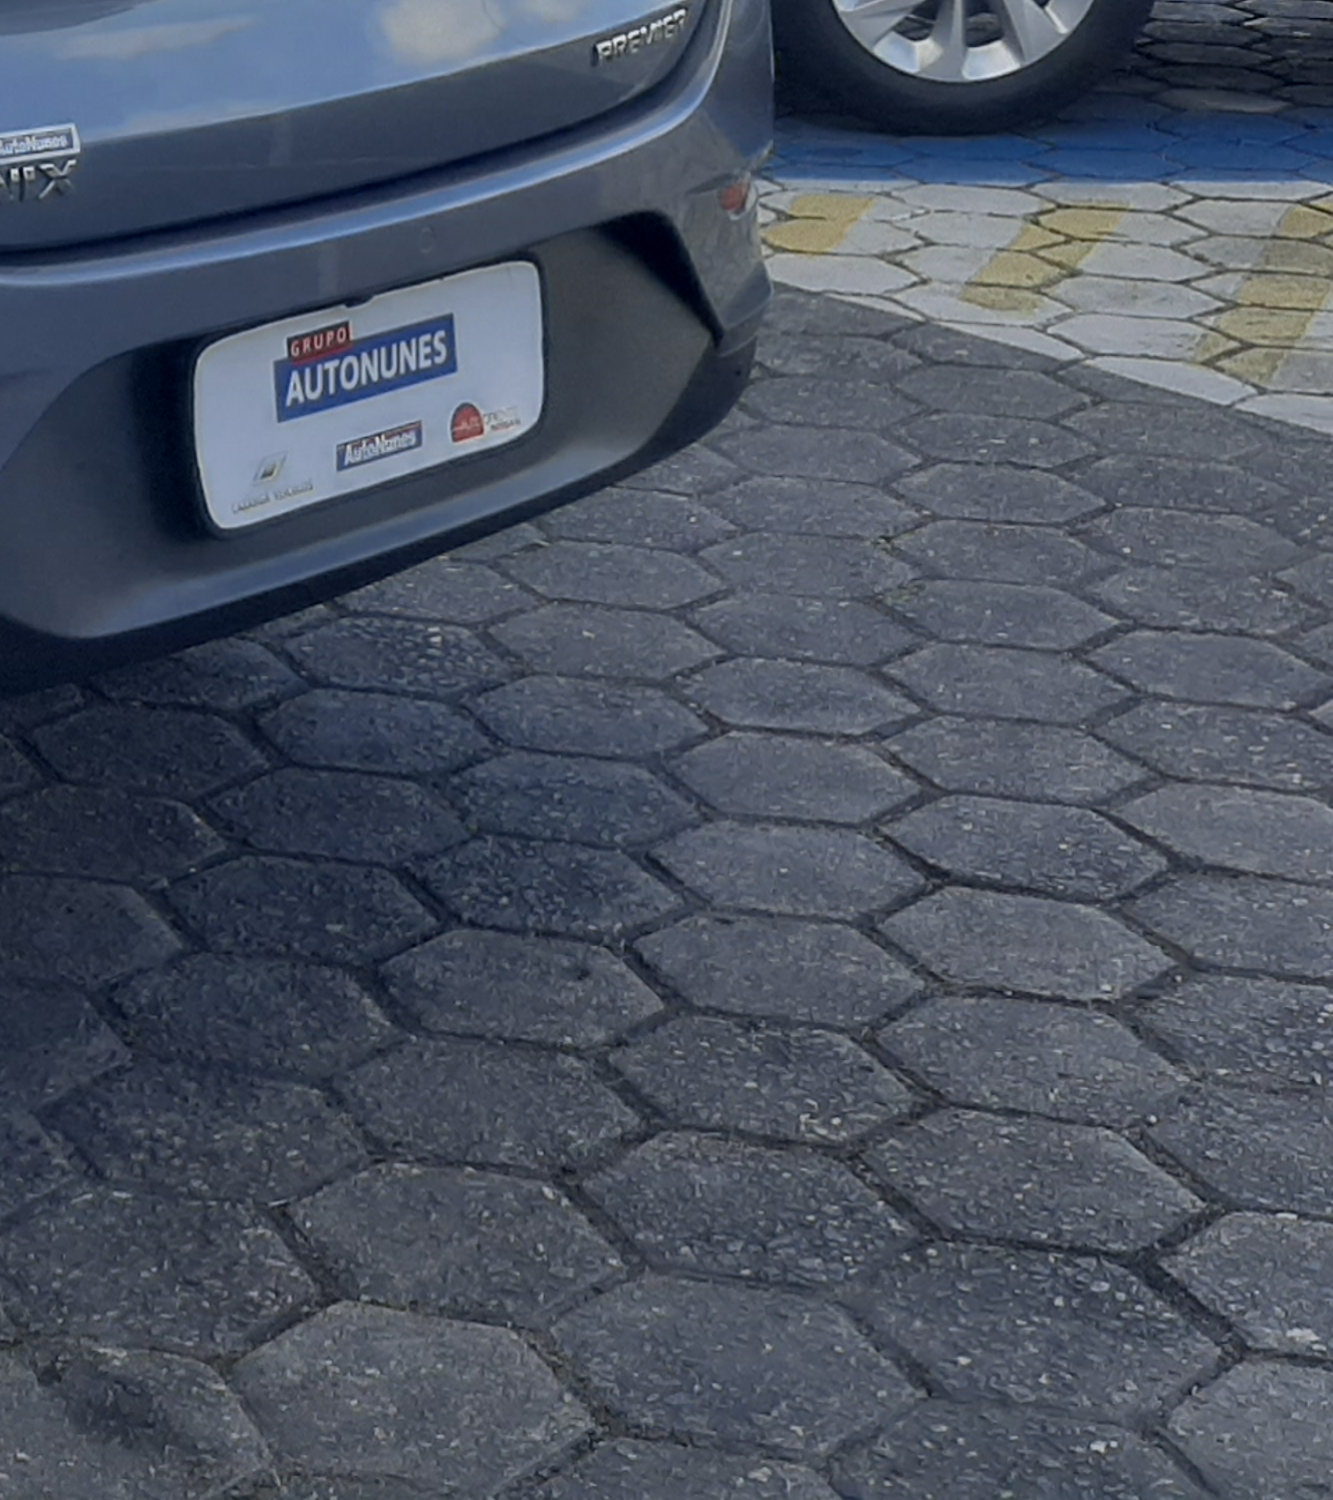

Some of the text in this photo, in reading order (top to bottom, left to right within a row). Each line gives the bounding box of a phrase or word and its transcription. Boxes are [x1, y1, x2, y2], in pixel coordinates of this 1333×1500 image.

[595, 7, 687, 60] PREMIER
[285, 329, 448, 407] AUTONUNES
[290, 326, 347, 358] GRUPO
